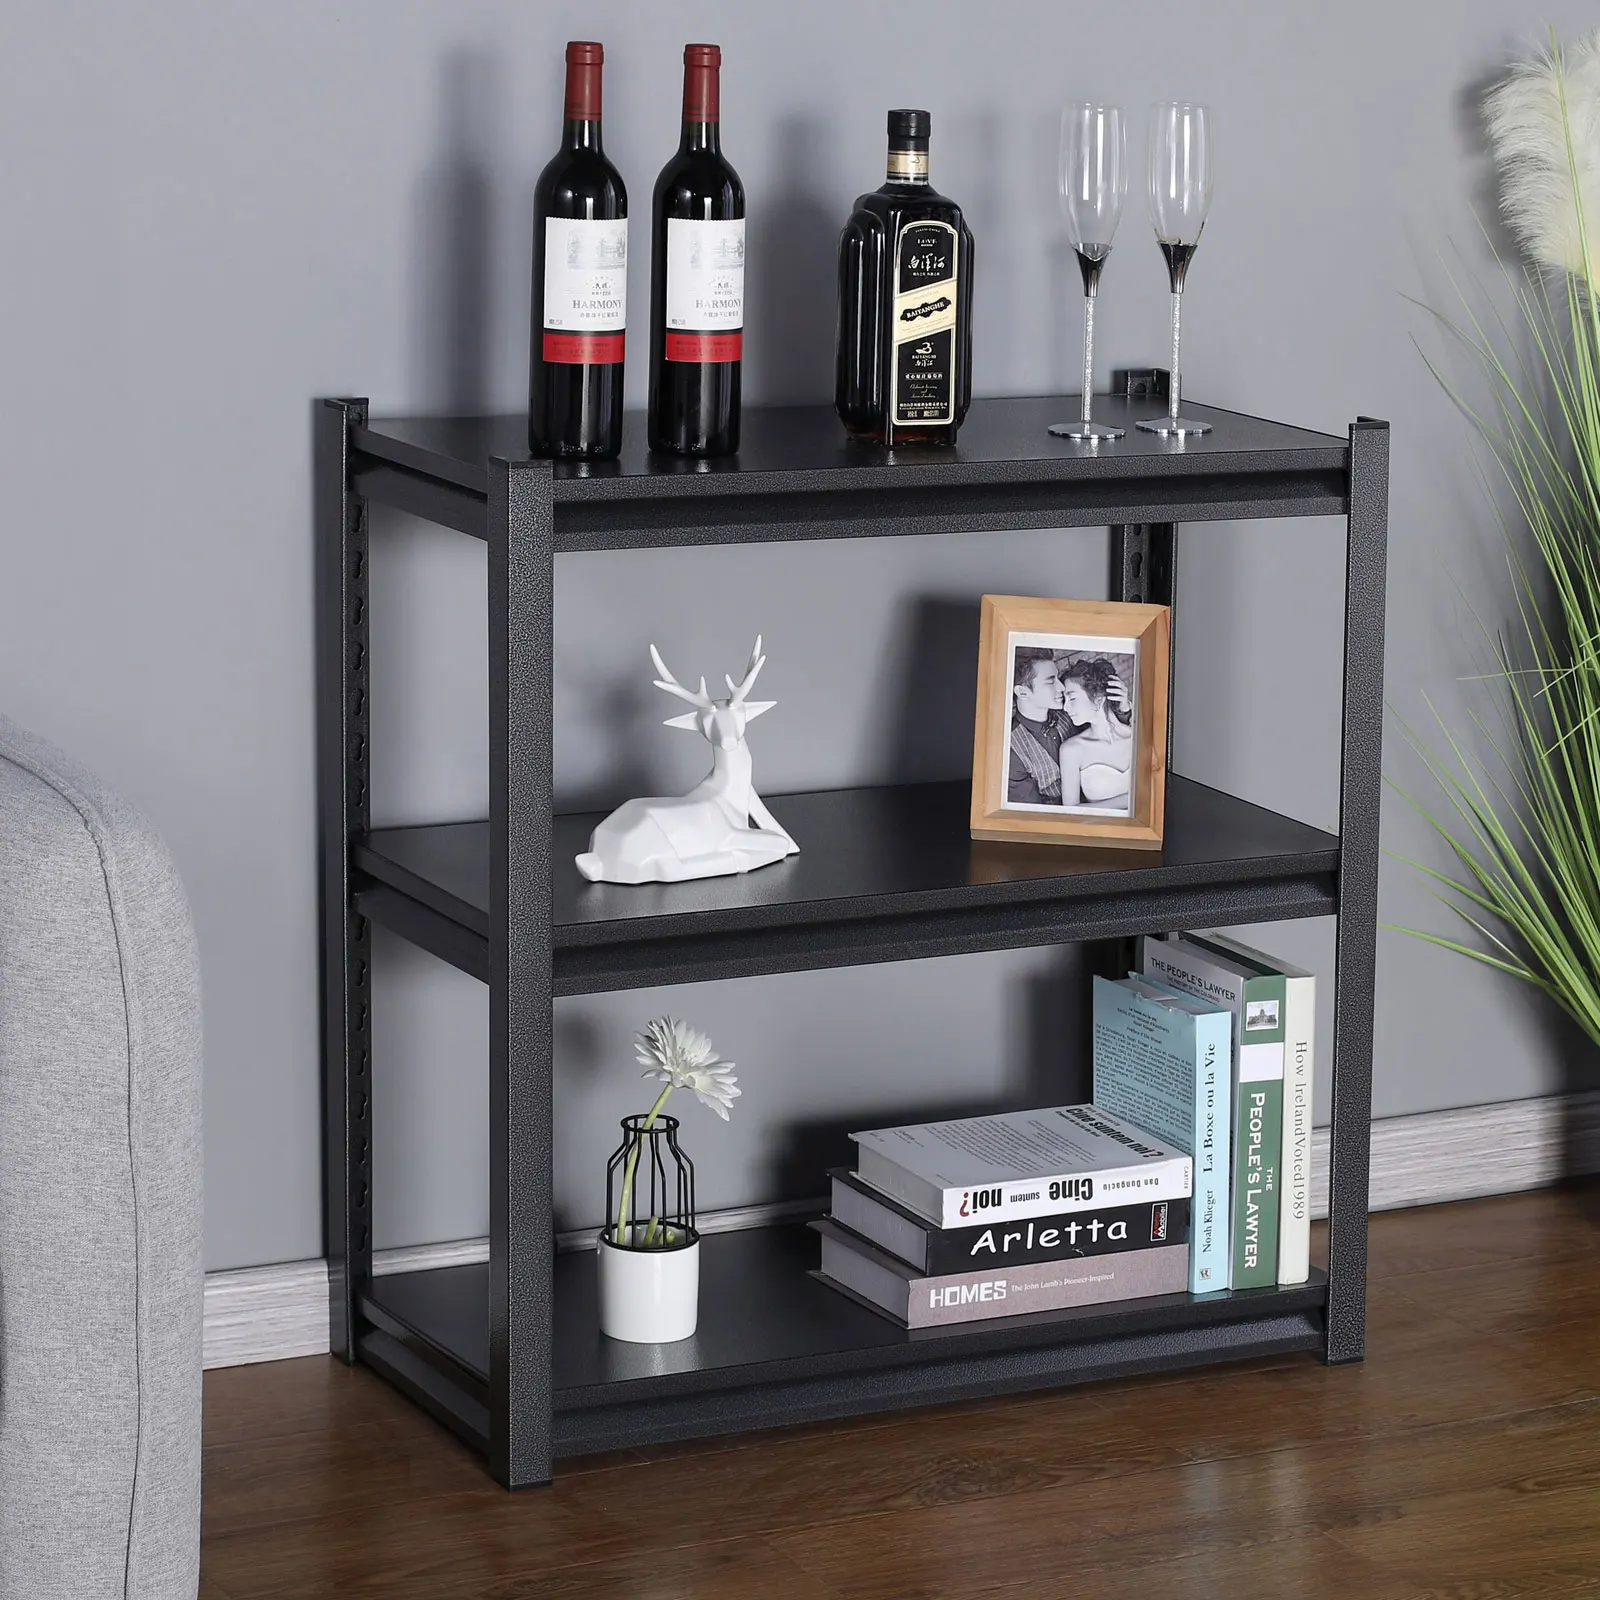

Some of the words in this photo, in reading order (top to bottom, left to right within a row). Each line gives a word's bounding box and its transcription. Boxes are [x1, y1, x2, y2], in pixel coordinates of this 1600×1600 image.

[906, 301, 945, 319] BAIYANGHE
[1150, 956, 1166, 973] THE
[1166, 964, 1203, 988] PEOPLE'S
[1204, 980, 1236, 1002] LAWYER
[1205, 1043, 1216, 1068] Vie
[1295, 1042, 1307, 1076] How
[1205, 1072, 1215, 1085] la
[1207, 1089, 1215, 1108] ou
[1065, 1108, 1094, 1123] Cine
[1088, 1121, 1135, 1145] suntem
[1126, 1142, 1165, 1158] noi?
[1203, 1113, 1214, 1149] Boxe
[1247, 1092, 1266, 1184] PEOPLE'S
[1203, 1153, 1213, 1173] La
[1048, 1178, 1094, 1201] Cine
[1102, 1179, 1141, 1191] Dungaciu
[1144, 1178, 1159, 1186] Dan
[1265, 1167, 1274, 1191] THE
[1009, 1191, 1041, 1203] suntem
[1203, 1189, 1216, 1224] Klieger
[969, 1218, 1129, 1257] Arletta
[1202, 1226, 1213, 1253] Noah
[1244, 1189, 1262, 1268] LAWYER
[929, 1279, 1007, 1309] HOMES
[1011, 1283, 1023, 1293] The
[1024, 1280, 1040, 1293] John
[1063, 1271, 1115, 1286] Pioneer-Inspired
